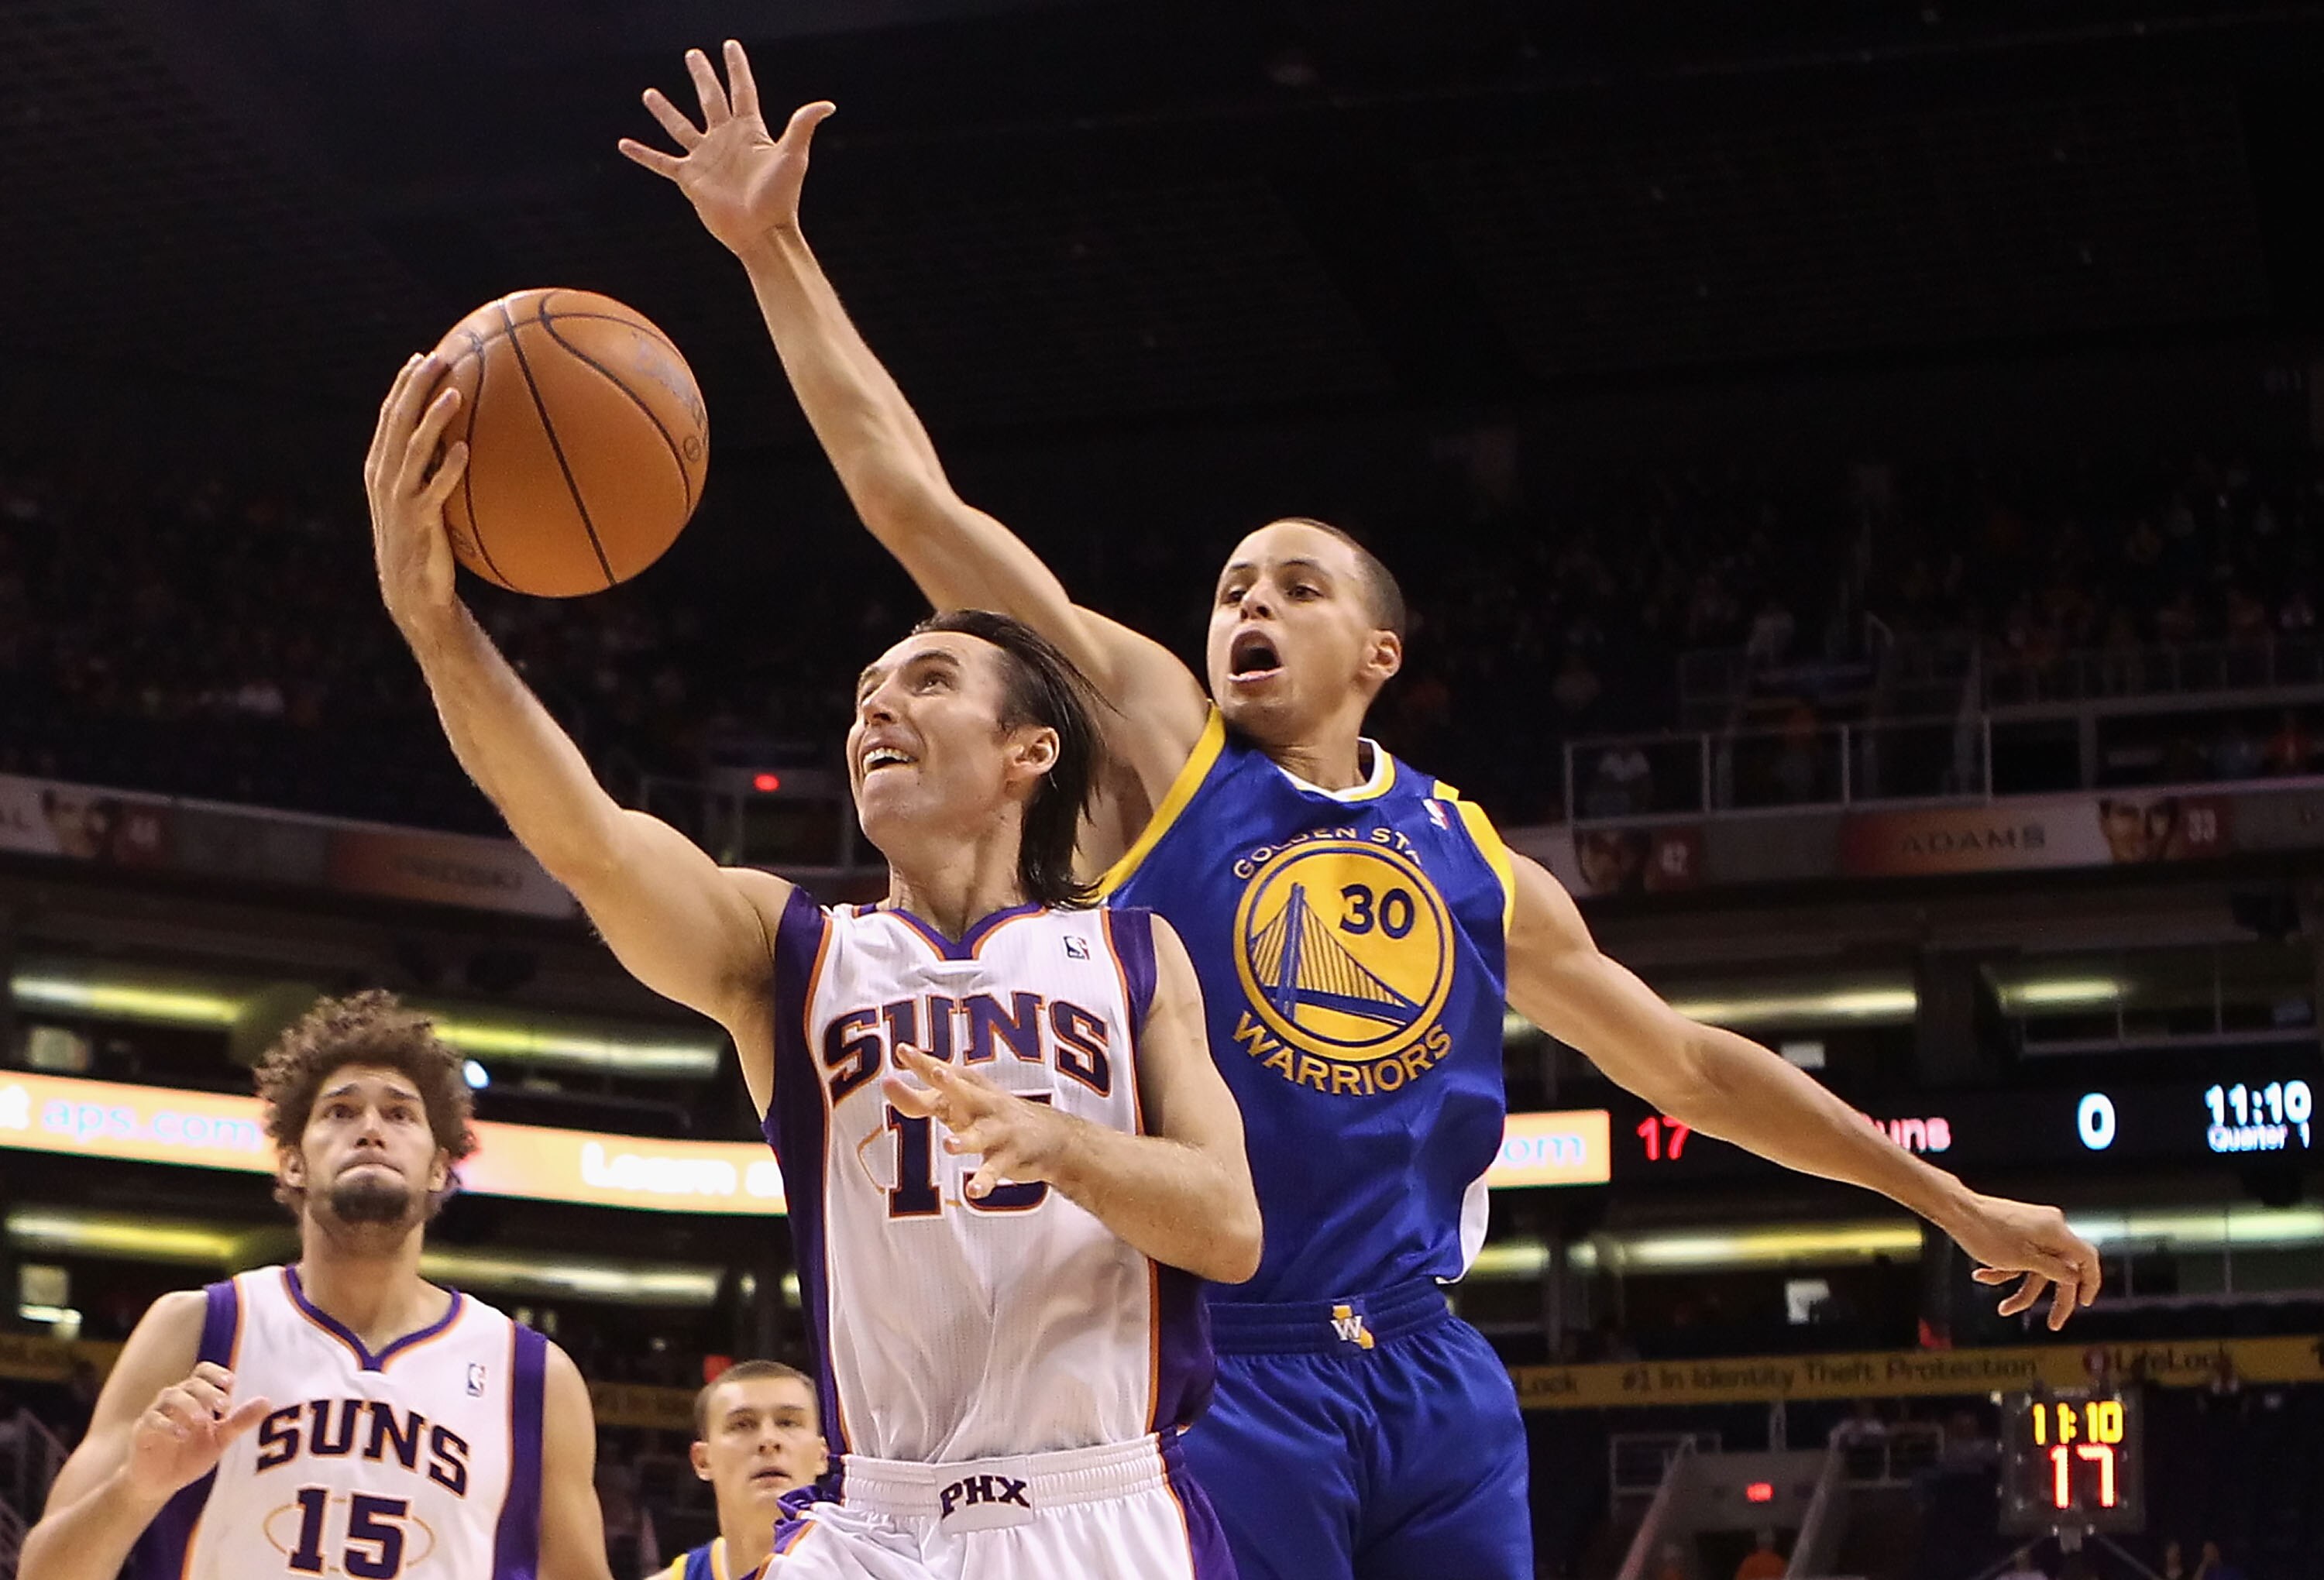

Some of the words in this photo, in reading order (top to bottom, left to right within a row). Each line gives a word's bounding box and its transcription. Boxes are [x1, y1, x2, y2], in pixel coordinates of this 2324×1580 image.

[1902, 823, 2046, 854] ADAMS
[1339, 883, 1415, 939] 30
[823, 990, 1112, 1109] SUNS
[1233, 1011, 1452, 1096] WARRIORS
[43, 1099, 260, 1148] aps.com
[2078, 1092, 2116, 1150] 0
[2205, 1080, 2312, 1125] 11:10
[1636, 1115, 1690, 1160] 17
[1860, 1112, 1951, 1152] uns
[1622, 1365, 1652, 1391] #1
[1659, 1365, 1684, 1389] In
[1692, 1359, 1794, 1392] Identity
[1806, 1356, 1875, 1382] Theft
[1886, 1355, 2037, 1382] Protection
[2033, 1401, 2123, 1445] 11:10
[255, 1397, 469, 1499] SUNS
[939, 1474, 1031, 1520] PHX
[2049, 1444, 2116, 1509] 17
[287, 1485, 412, 1580] 15
